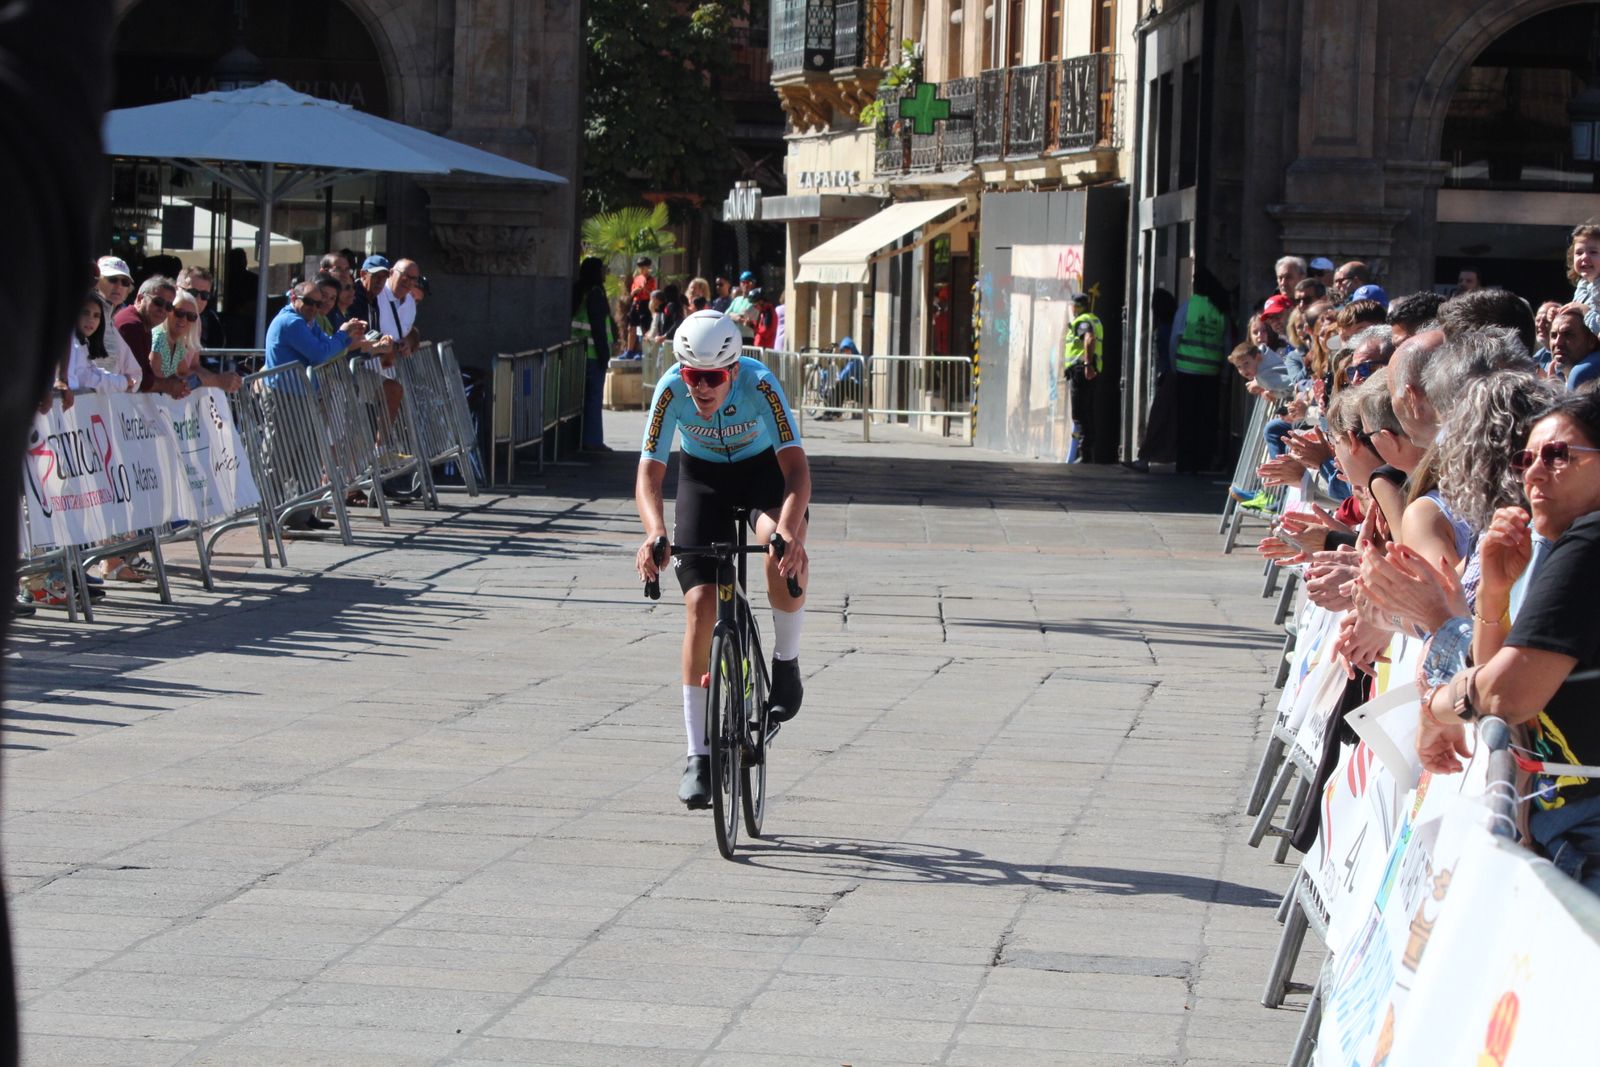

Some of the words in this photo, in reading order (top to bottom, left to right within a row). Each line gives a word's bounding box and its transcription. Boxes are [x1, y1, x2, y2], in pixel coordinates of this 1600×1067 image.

[797, 171, 860, 189] ZAPATOS
[645, 387, 674, 452] X-SAUCE
[757, 380, 794, 444] X-SAUCE
